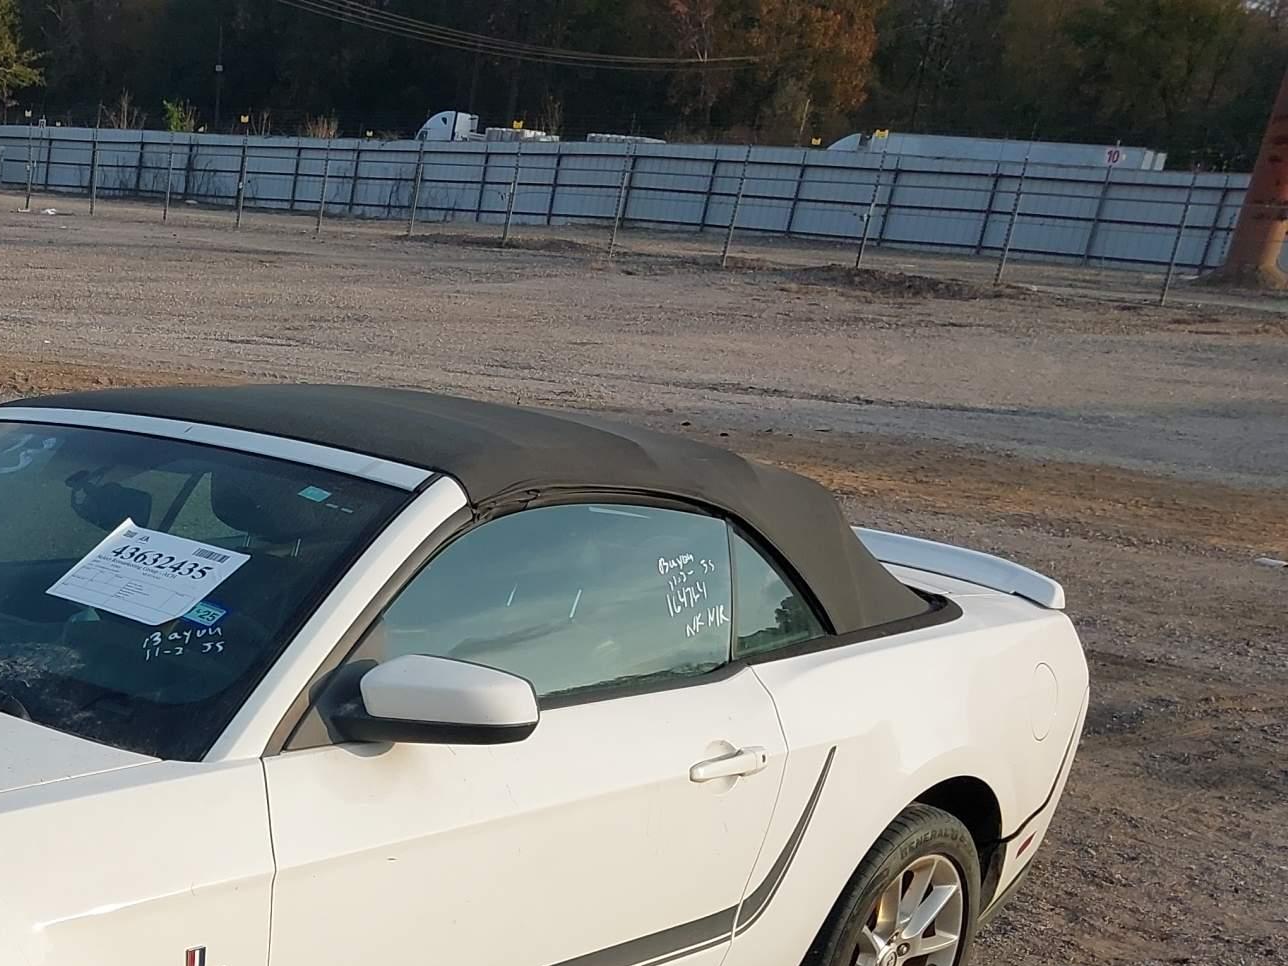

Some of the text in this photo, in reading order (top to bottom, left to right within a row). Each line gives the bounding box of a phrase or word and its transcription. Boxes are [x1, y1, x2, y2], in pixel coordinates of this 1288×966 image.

[1107, 150, 1120, 164] 10
[112, 545, 214, 580] 43632435
[198, 610, 220, 622] 25
